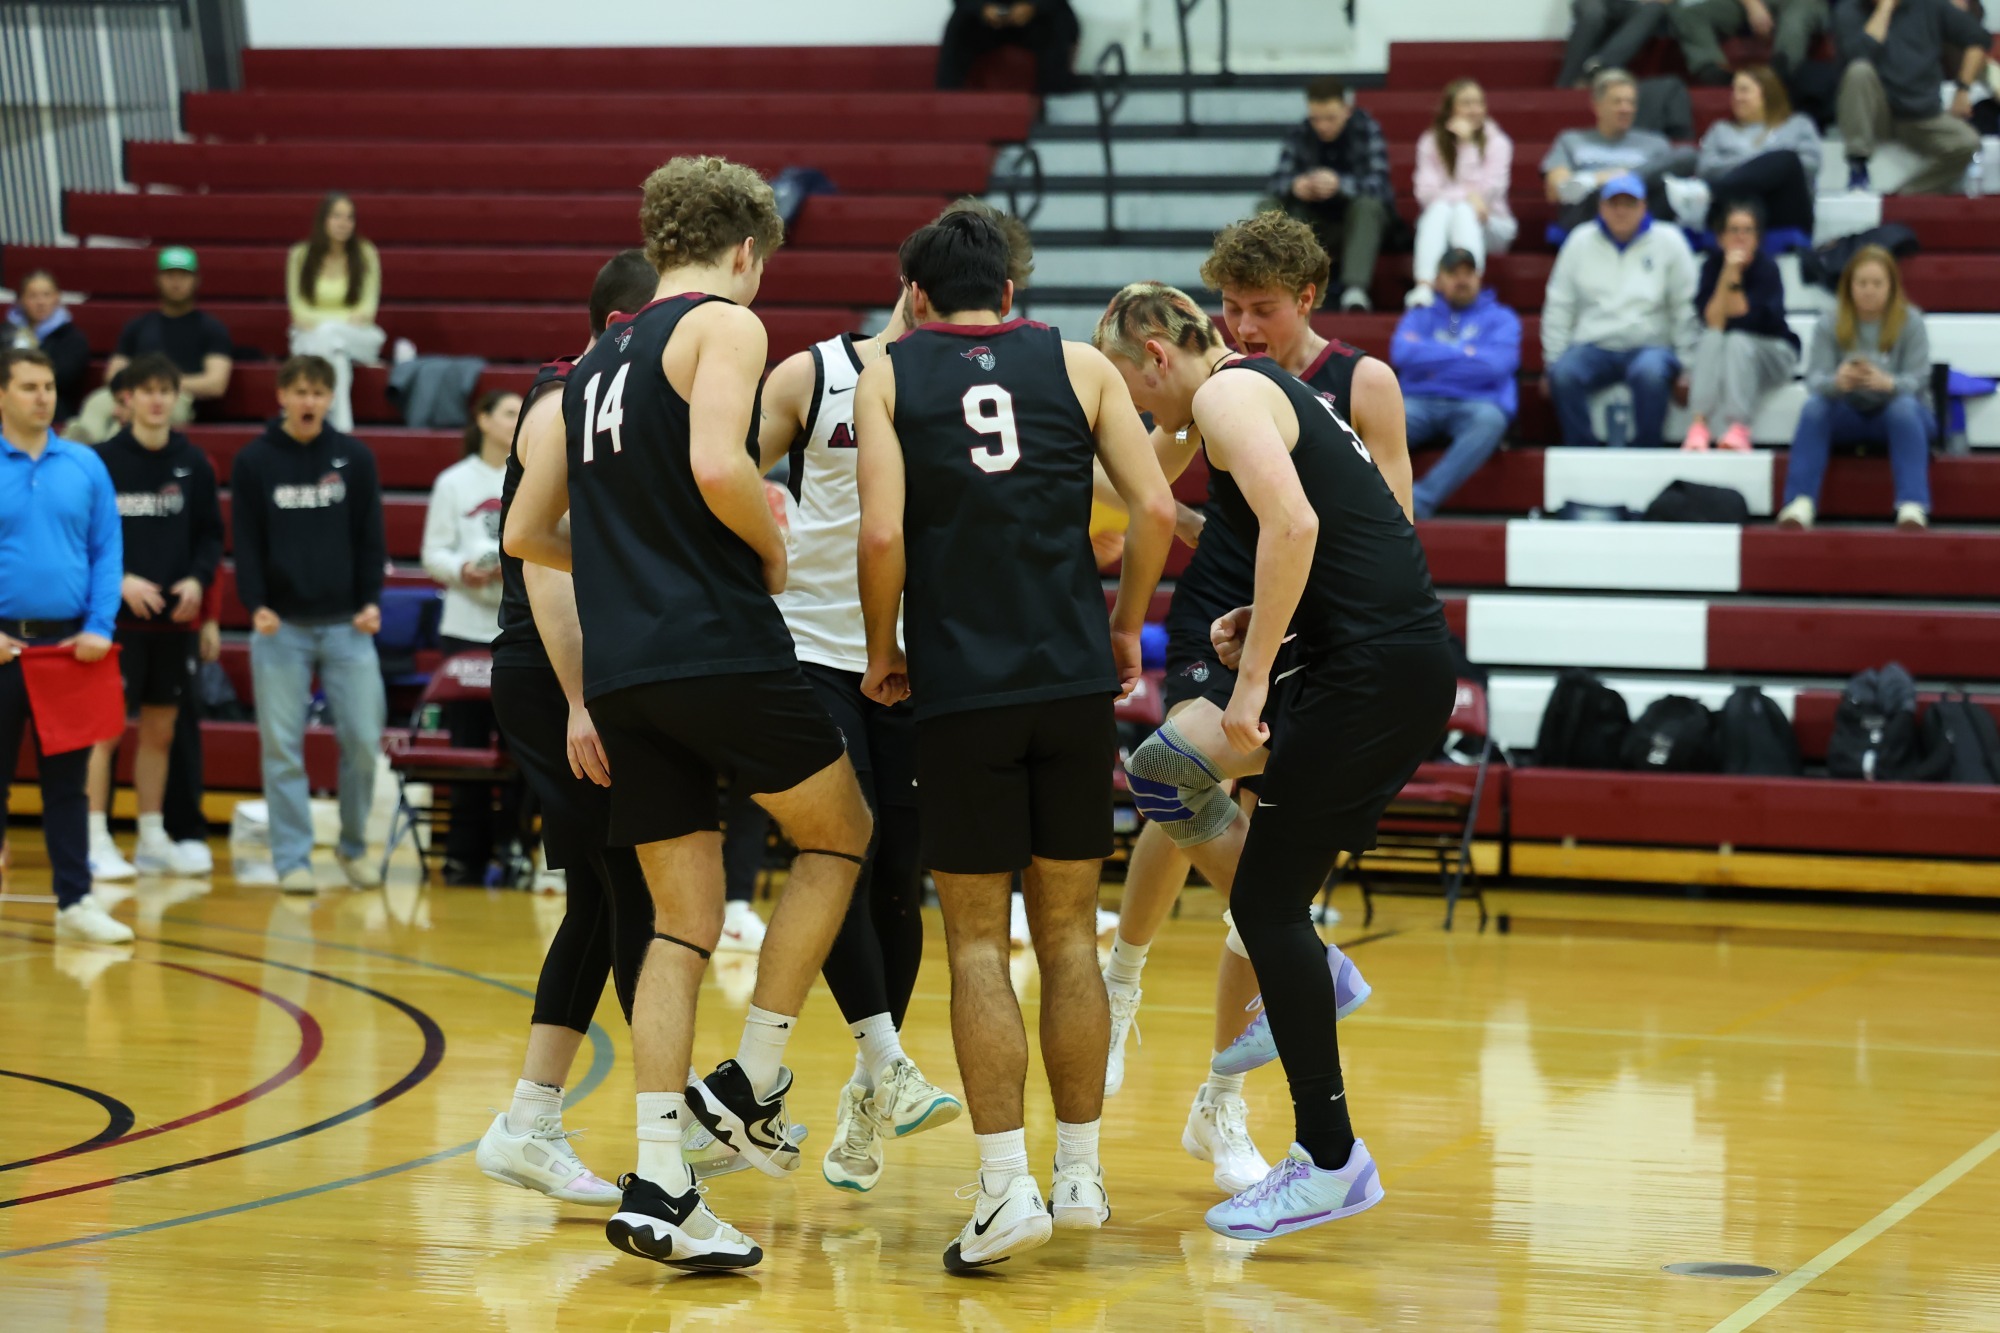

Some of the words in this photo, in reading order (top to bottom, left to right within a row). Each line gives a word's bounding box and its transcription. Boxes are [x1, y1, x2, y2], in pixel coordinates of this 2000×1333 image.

[583, 361, 632, 464] 14
[827, 422, 859, 449] A
[961, 383, 1022, 474] 9
